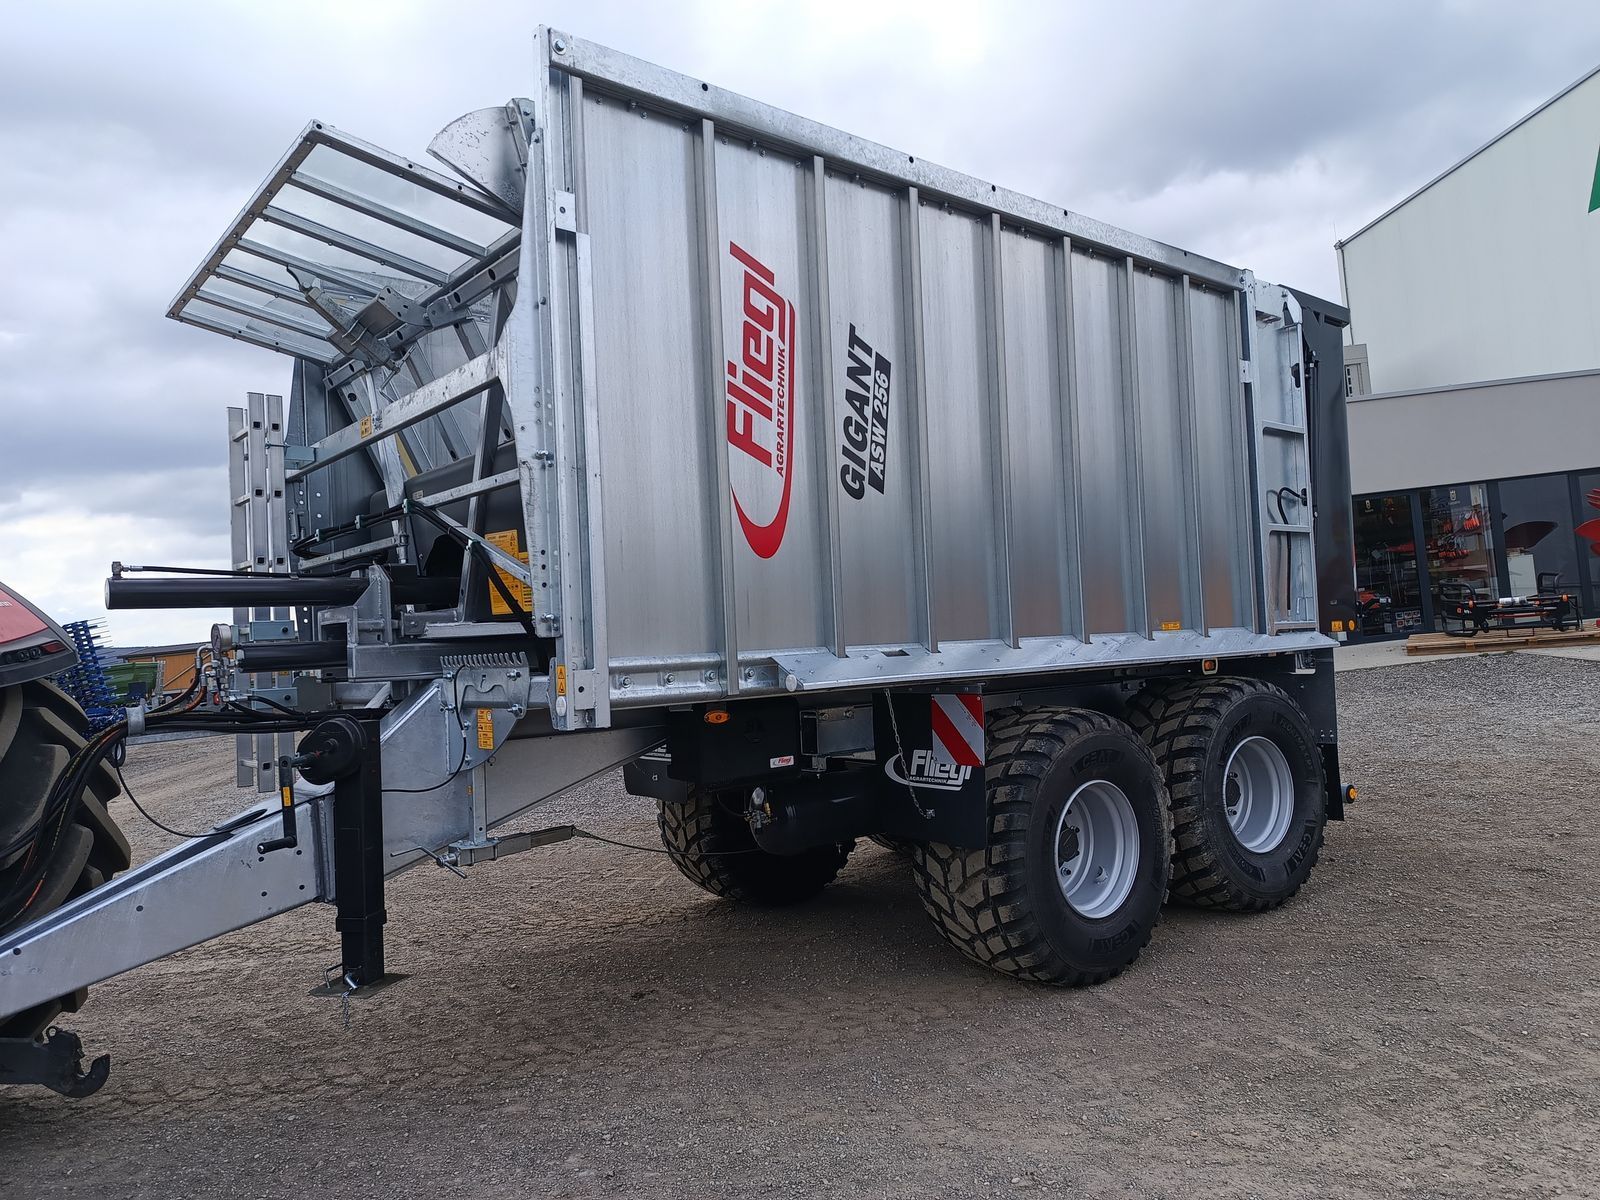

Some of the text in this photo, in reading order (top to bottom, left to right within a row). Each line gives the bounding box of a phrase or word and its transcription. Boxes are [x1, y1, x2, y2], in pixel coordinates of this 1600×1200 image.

[727, 240, 786, 468] Fliegl
[776, 345, 786, 477] AGRARTECHNIK
[840, 323, 873, 501] GIGANT
[871, 370, 889, 480] ASW 256
